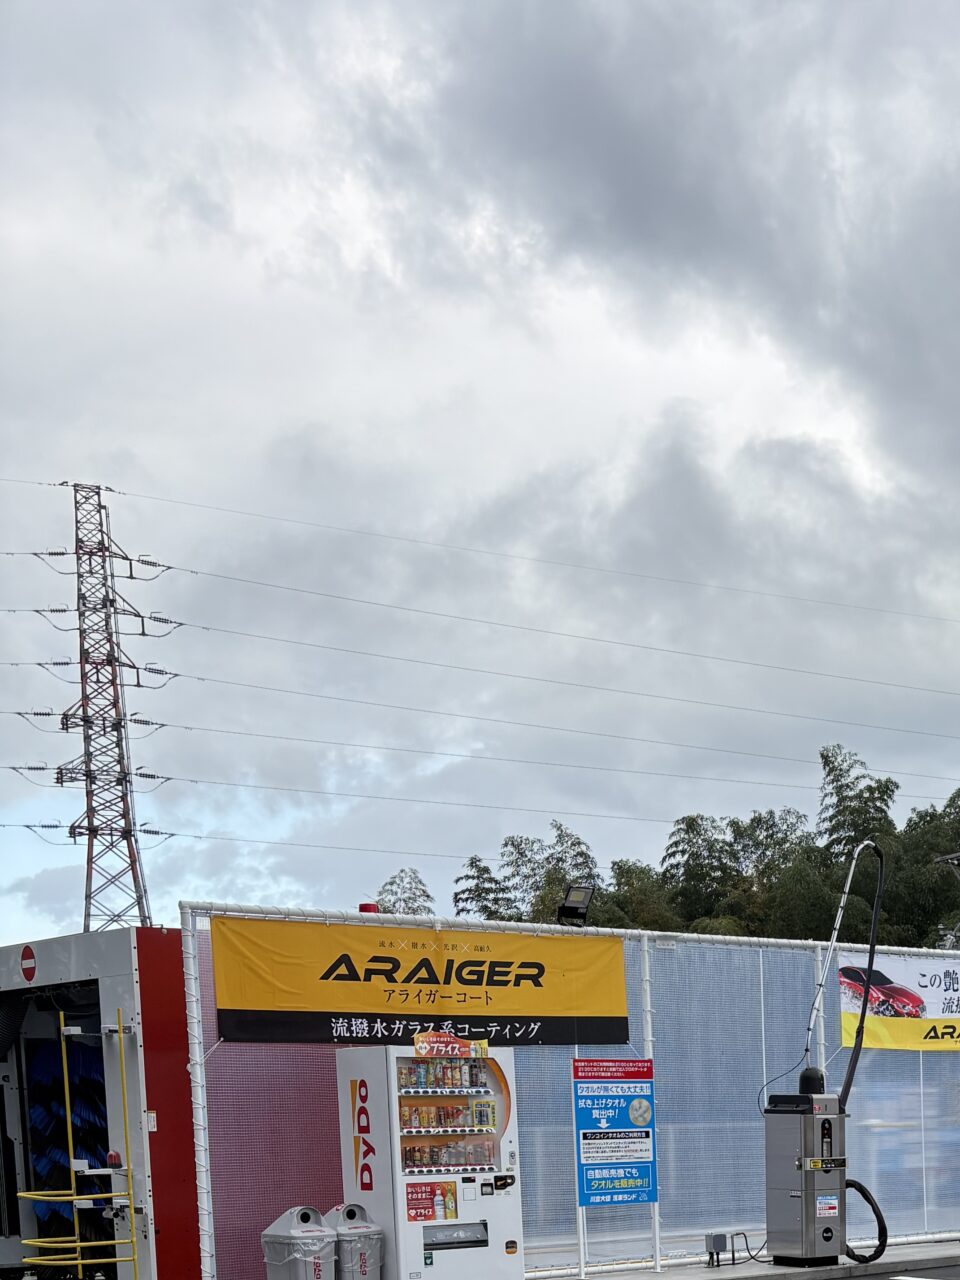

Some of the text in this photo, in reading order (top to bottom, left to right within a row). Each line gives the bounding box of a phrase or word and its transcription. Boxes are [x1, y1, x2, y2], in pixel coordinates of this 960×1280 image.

[319, 953, 546, 987] ARAIGER
[383, 988, 493, 1006] アライガーコート
[331, 1017, 542, 1039] 流撥水ガラス系コーティング
[578, 1098, 627, 1108] 拭き上げタオル
[587, 1168, 639, 1179] 自動販売機でも
